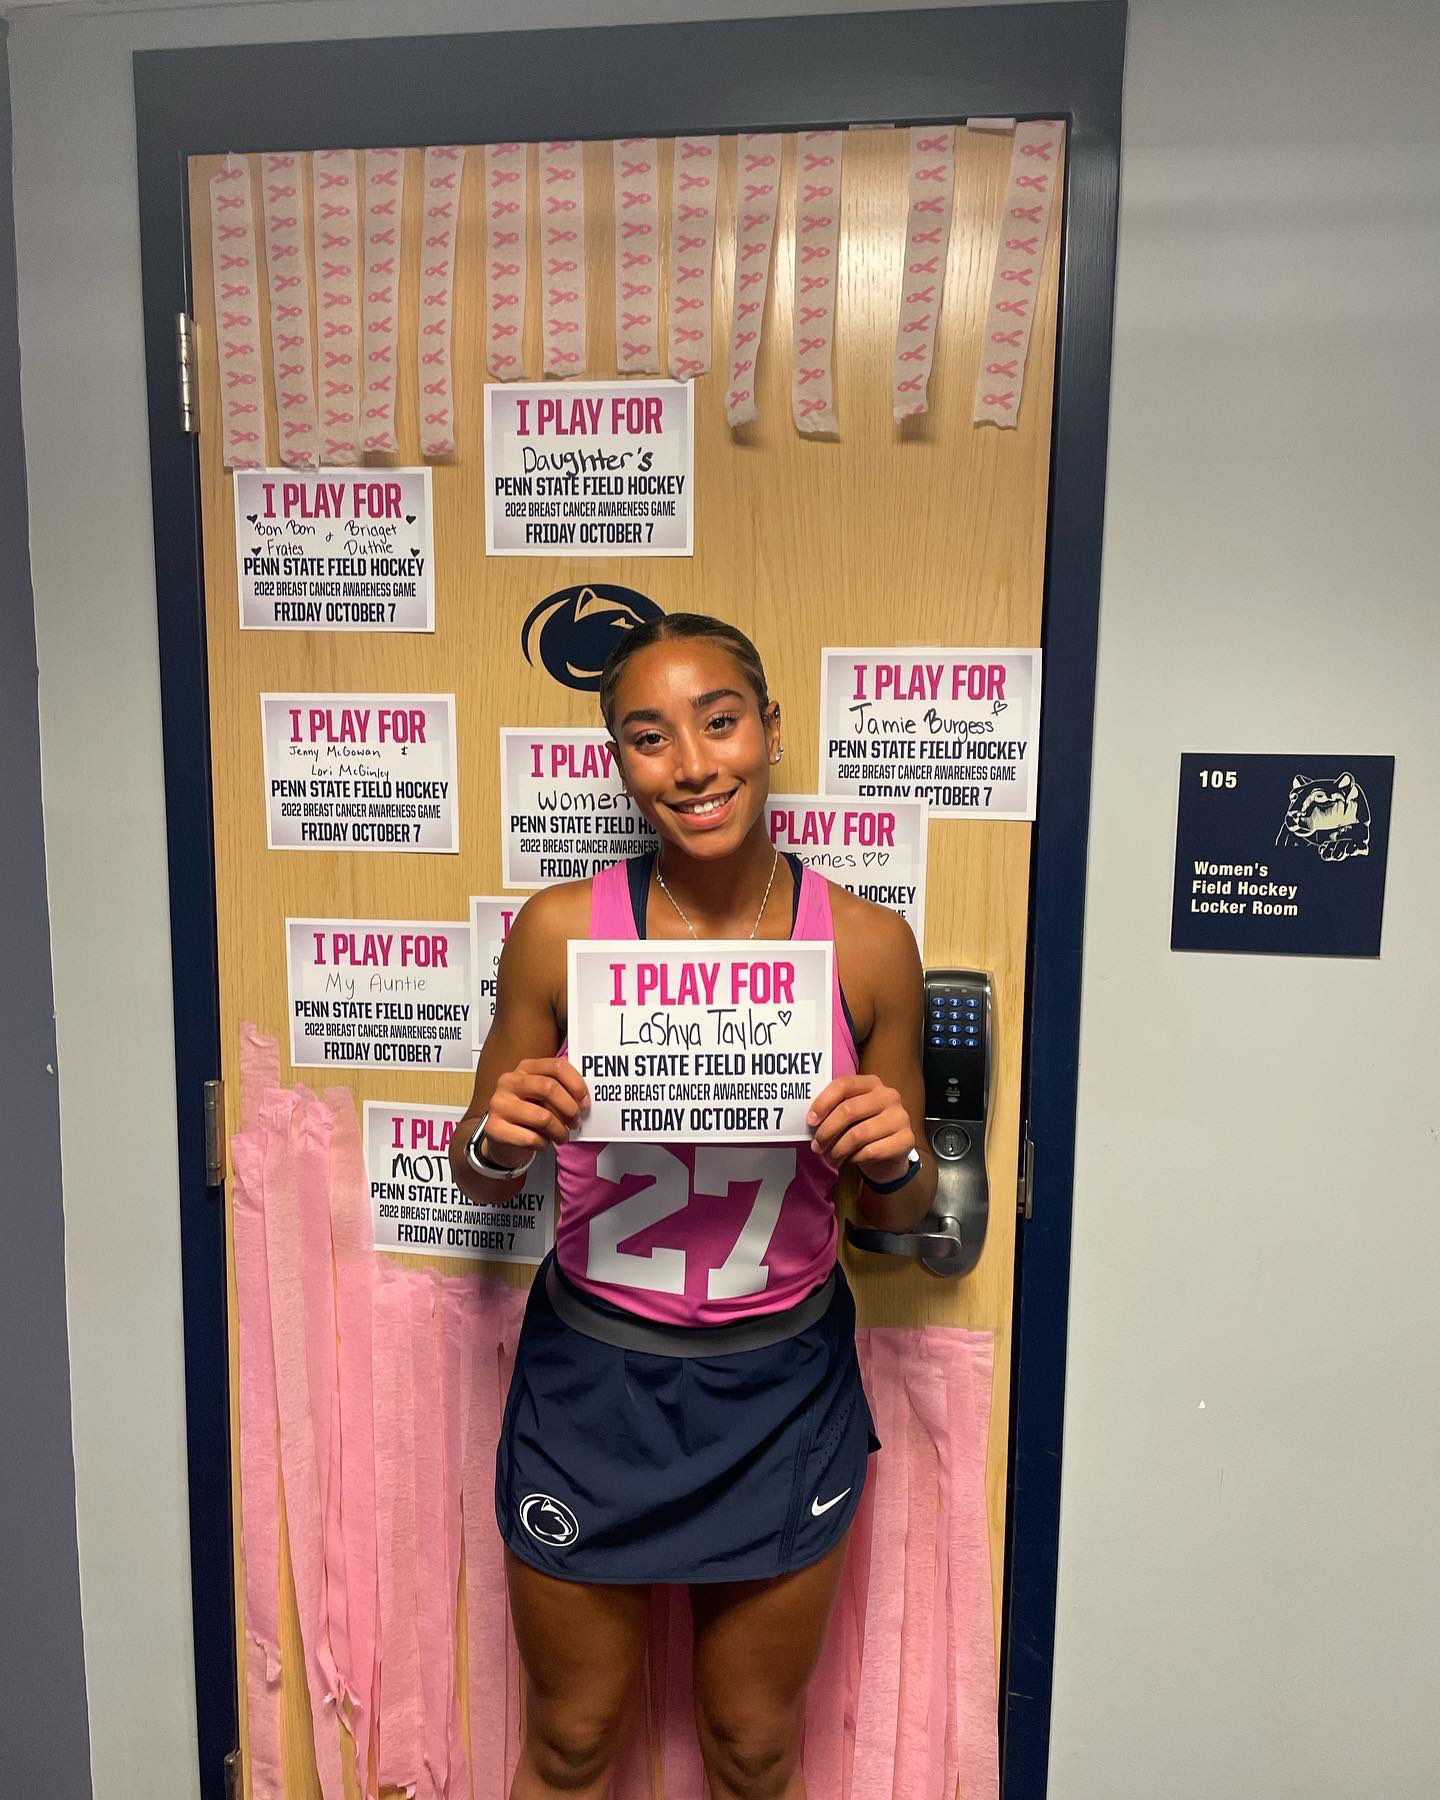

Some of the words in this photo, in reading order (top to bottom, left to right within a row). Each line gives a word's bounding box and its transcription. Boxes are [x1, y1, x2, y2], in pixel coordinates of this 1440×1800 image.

[517, 400, 529, 435] I
[538, 399, 603, 435] PLAY
[612, 397, 663, 434] FOR
[523, 447, 654, 477] Daughter's
[495, 477, 532, 496] PENN
[537, 477, 579, 495] STATE
[583, 476, 623, 495] FIELD
[628, 475, 685, 495] HOCKEY
[262, 484, 276, 518] I
[283, 483, 345, 518] PLAY
[353, 483, 402, 518] FOR
[505, 502, 526, 517] 2022
[529, 502, 561, 517] BREAST
[563, 502, 595, 516] CANCER
[598, 501, 649, 516] AWARENESS
[651, 501, 675, 516] GAME
[286, 520, 315, 535] Bon
[526, 523, 576, 544] FRIDAY
[580, 523, 642, 543] OCTOBER
[645, 523, 653, 543] 7
[344, 540, 393, 555] Duthie
[244, 558, 280, 576] PENN
[284, 558, 324, 576] STATE
[328, 558, 366, 576] FIELD
[371, 558, 424, 576] HOCKEY
[254, 582, 274, 596] 2022
[276, 582, 307, 596] BREAST
[310, 582, 341, 596] CANCER
[343, 583, 391, 597] AWARENESS
[393, 583, 416, 597] GAME
[275, 602, 322, 622] FRIDAY
[326, 603, 385, 622] OCTOBER
[388, 603, 396, 622] 7
[853, 665, 867, 700] I
[875, 665, 944, 700] PLAY
[952, 665, 1006, 700] FOR
[289, 710, 303, 742] I
[309, 710, 370, 742] PLAY
[378, 710, 426, 743] FOR
[849, 702, 916, 735] Jamie
[924, 708, 994, 744] Burgess
[289, 746, 319, 761] Jenny
[327, 746, 381, 758] McGowan
[829, 740, 867, 758] PENN
[872, 741, 916, 759] STATE
[920, 741, 961, 759] FIELD
[967, 741, 1027, 759] HOCKEY
[531, 745, 544, 777] I
[551, 745, 612, 778] PLAY
[311, 765, 332, 776] Lori
[339, 764, 389, 781] McGinley
[838, 765, 860, 778] 2022
[862, 765, 896, 779] BREAST
[898, 765, 932, 779] CANCER
[934, 766, 988, 780] AWARENESS
[990, 766, 1016, 780] GAME
[1200, 771, 1237, 788] 105
[272, 780, 306, 797] PENN
[310, 781, 350, 798] STATE
[354, 781, 392, 798] FIELD
[396, 782, 448, 799] HOCKEY
[984, 787, 992, 806] 7
[282, 803, 302, 817] 2022
[304, 804, 333, 817] BREAST
[336, 804, 367, 818] CANCER
[369, 804, 416, 818] AWARENESS
[418, 805, 441, 818] GAME
[302, 823, 348, 841] FRIDAY
[352, 823, 410, 842] OCTOBER
[413, 824, 421, 842] 7
[511, 816, 546, 832] PENN
[551, 816, 591, 833] STATE
[595, 817, 634, 834] FIELD
[771, 811, 836, 845] PLAY
[844, 812, 895, 846] FOR
[520, 839, 540, 852] 2022
[543, 839, 573, 853] BREAST
[576, 840, 608, 853] CANCER
[610, 840, 658, 854] AWARENESS
[540, 859, 588, 877] FRIDAY
[793, 852, 856, 868] ennes
[1194, 861, 1268, 877] Women's
[858, 885, 916, 904] HOCKEY
[1192, 881, 1231, 894] Field
[1238, 882, 1297, 899] Hockey
[1191, 900, 1246, 914] Locker
[1252, 901, 1298, 916] Room
[313, 933, 326, 964] I
[333, 934, 393, 966] PLAY
[401, 935, 448, 967] FOR
[326, 973, 355, 1000] My
[370, 973, 426, 992] Auntie
[610, 964, 626, 1006] I
[637, 963, 720, 1005] PLAY
[731, 962, 794, 1004] FOR
[295, 1001, 329, 1018] PENN
[333, 1002, 372, 1019] STATE
[376, 1003, 413, 1020] FIELD
[418, 1004, 469, 1021] HOCKEY
[305, 1023, 325, 1036] 2022
[326, 1024, 356, 1037] BREAST
[358, 1025, 388, 1038] CANCER
[390, 1025, 437, 1039] AWARENESS
[439, 1027, 461, 1040] GAME
[707, 1009, 777, 1050] Taylor
[325, 1042, 370, 1060] FRIDAY
[374, 1043, 430, 1062] OCTOBER
[434, 1045, 442, 1062] 7
[582, 1055, 629, 1077] PENN
[635, 1055, 689, 1076] STATE
[695, 1054, 746, 1075] FIELD
[752, 1052, 822, 1075] HOCKEY
[594, 1085, 621, 1101] 2022
[625, 1085, 666, 1101] BREAST
[669, 1084, 710, 1100] CANCER
[713, 1083, 777, 1099] AWARENESS
[780, 1083, 811, 1099] GAME
[621, 1109, 685, 1131] FRIDAY
[690, 1108, 768, 1130] OCTOBER
[773, 1108, 784, 1129] 7
[392, 1118, 404, 1148] I
[412, 1119, 461, 1151] PLA
[371, 1182, 404, 1200] PENN
[408, 1185, 447, 1204] STATE
[380, 1205, 399, 1218] 2022
[401, 1206, 430, 1220] BREAST
[432, 1209, 462, 1224] CANCER
[464, 1212, 511, 1227] AWARENESS
[513, 1215, 535, 1229] GAME
[586, 1143, 797, 1300] 27
[398, 1224, 443, 1244] FRIDAY
[447, 1227, 505, 1248] OCTOBER
[507, 1233, 515, 1250] 7
